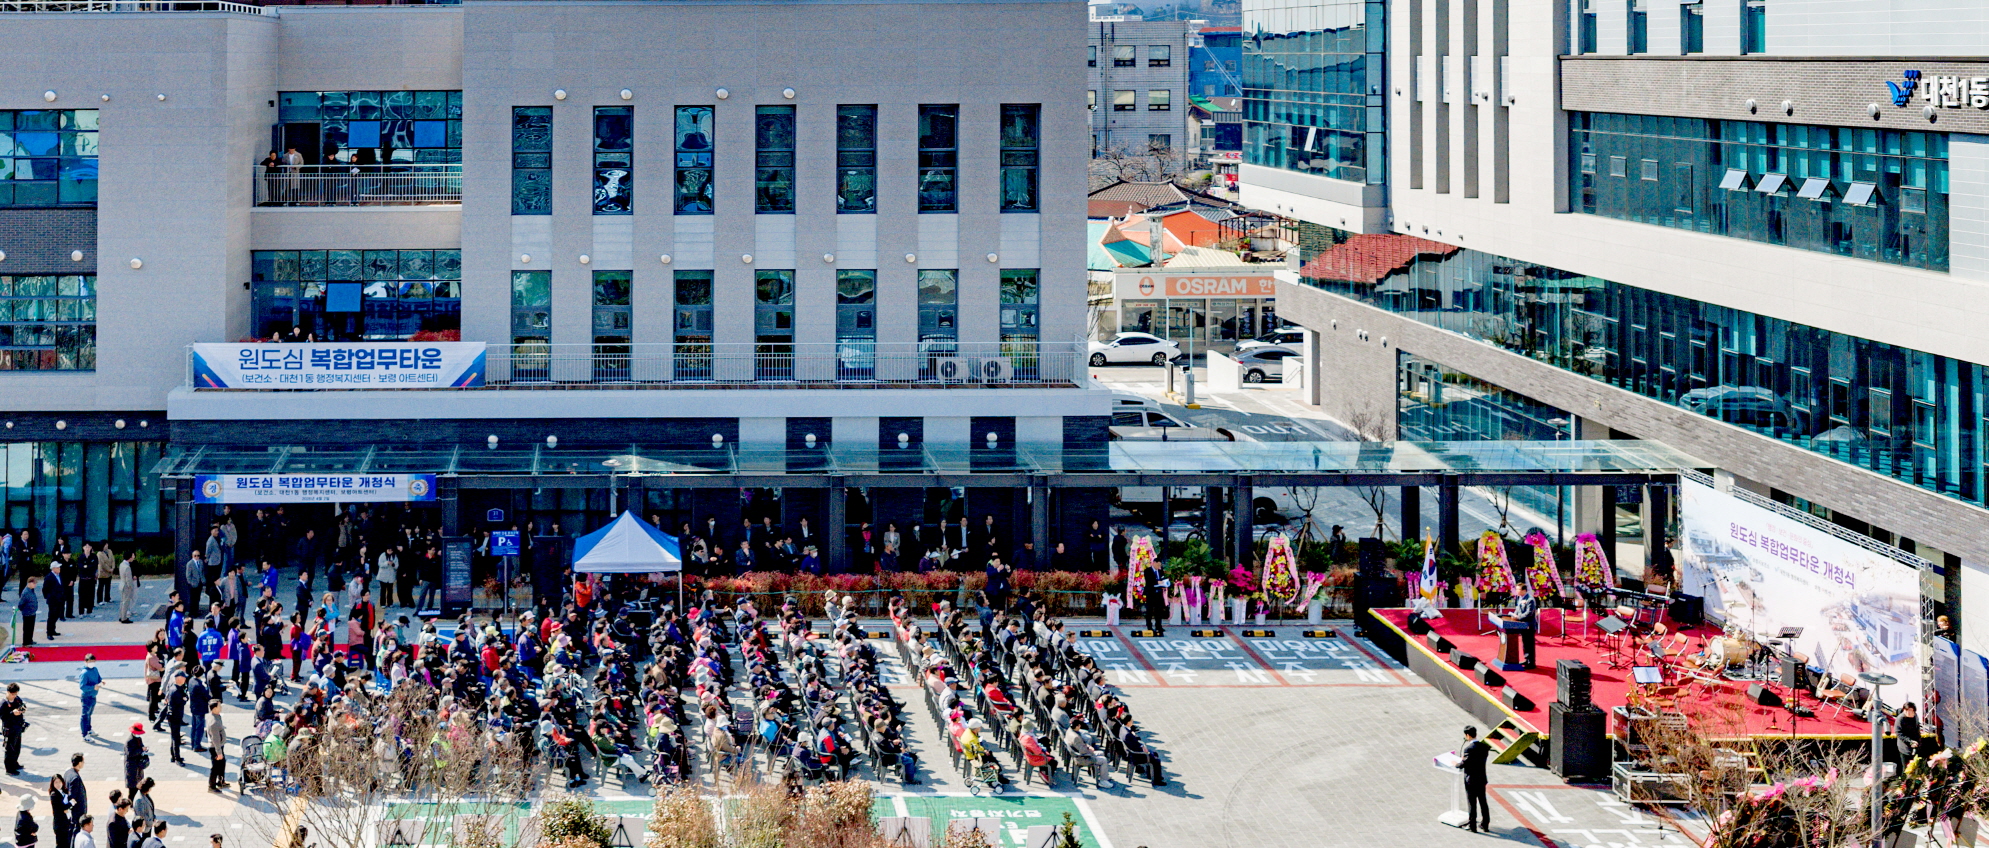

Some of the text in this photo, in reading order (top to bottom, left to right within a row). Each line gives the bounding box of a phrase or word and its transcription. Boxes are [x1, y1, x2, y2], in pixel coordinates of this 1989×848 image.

[1921, 75, 1989, 108] 대천1동
[1176, 278, 1275, 294] OSRAM 한
[239, 348, 442, 370] 원도심 복합업무타운
[241, 373, 438, 384] (보건소 대천1동 행정복지센터 보령 아트센터)
[1241, 425, 1308, 435] OUT
[236, 476, 395, 489] 원도심 복합업무타운 개청식
[498, 537, 506, 546] P
[1730, 522, 1757, 548] 원도심
[1760, 534, 1820, 575] 복합업무타운
[1823, 560, 1855, 590] 개청식
[1138, 640, 1245, 660] 민원인
[1250, 640, 1361, 660] 민원인
